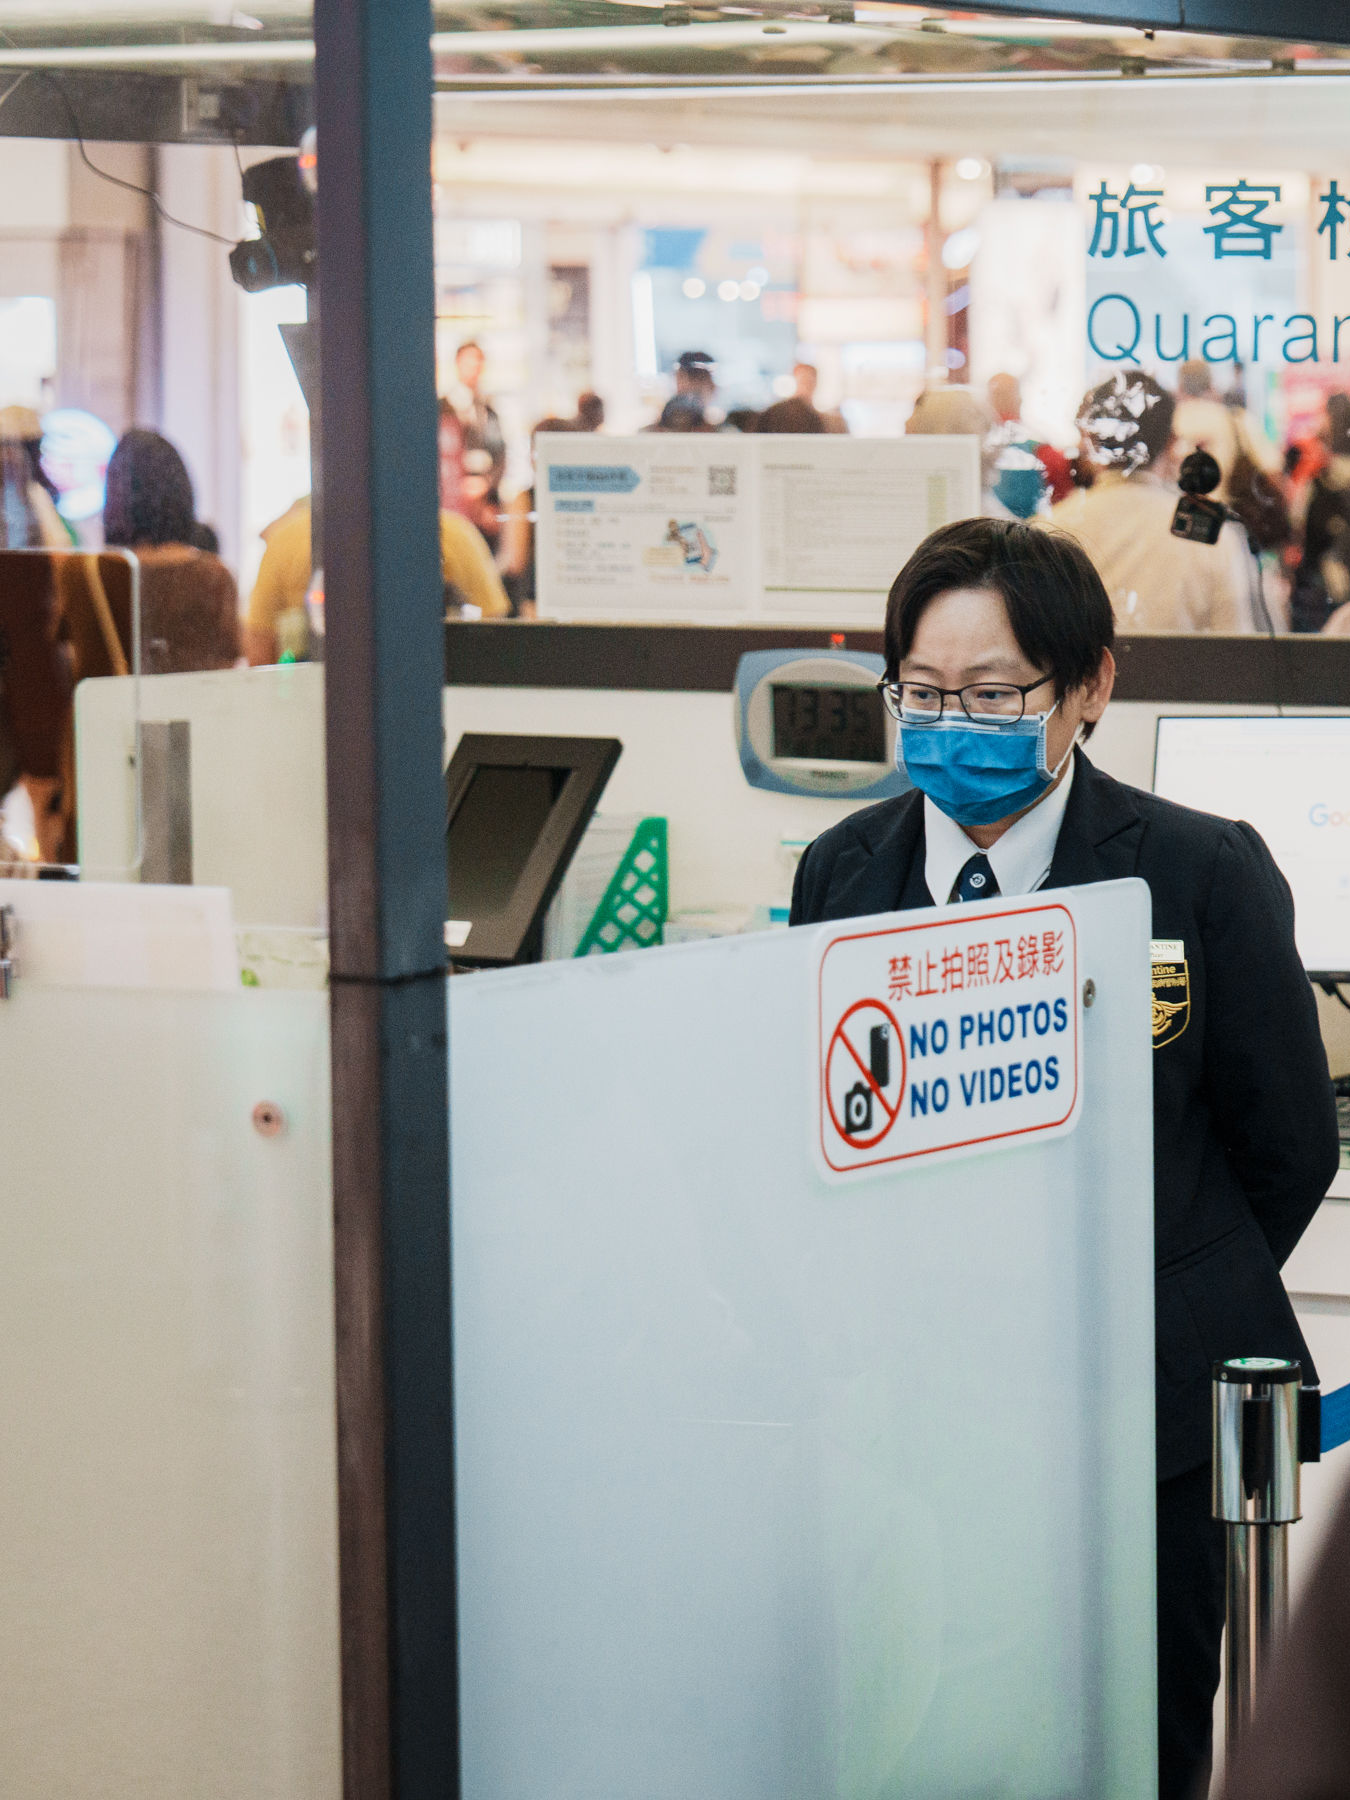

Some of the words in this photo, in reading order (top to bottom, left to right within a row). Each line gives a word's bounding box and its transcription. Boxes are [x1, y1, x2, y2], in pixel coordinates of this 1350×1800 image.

[888, 931, 1064, 1001] 禁止拍照及錄影
[1152, 965, 1177, 976] ntine
[910, 1018, 949, 1059] NO
[960, 997, 1068, 1050] PHOTOS
[911, 1077, 950, 1118] NO
[960, 1055, 1060, 1107] VIDEOS
